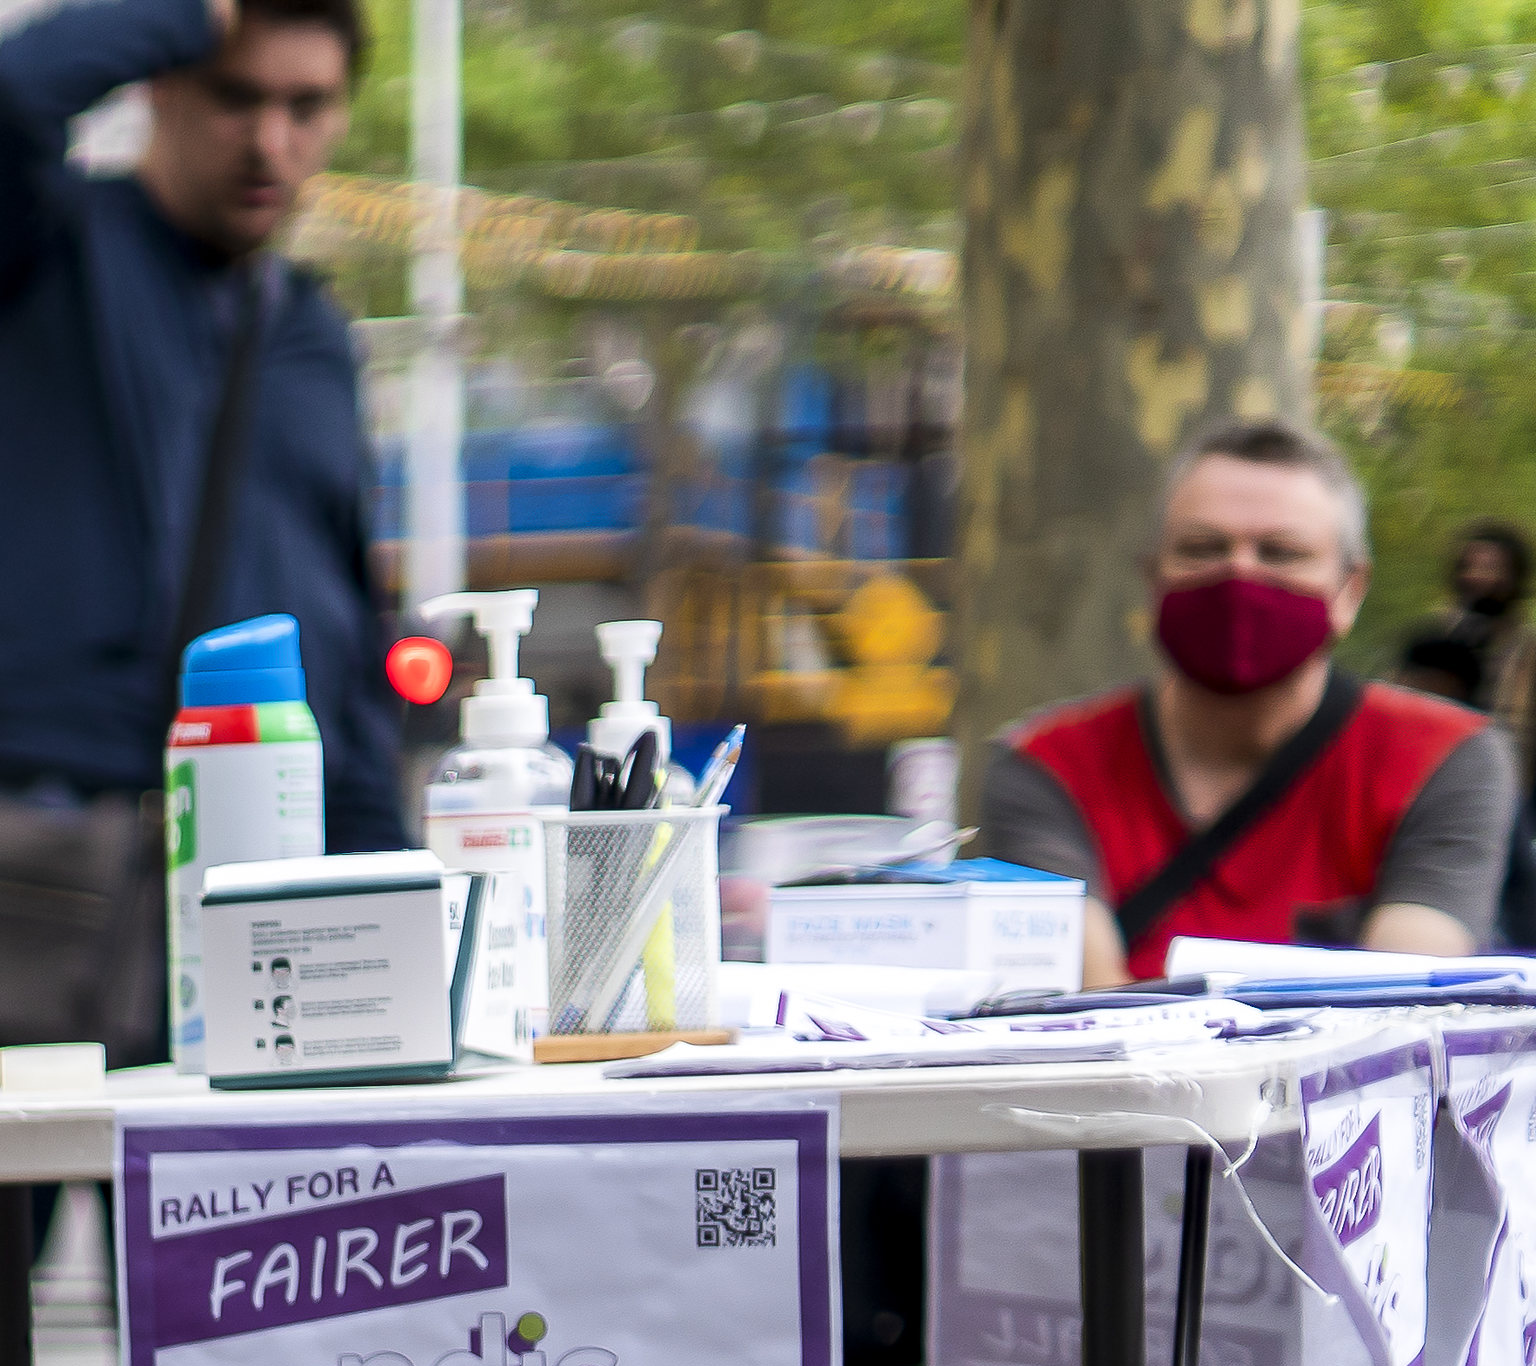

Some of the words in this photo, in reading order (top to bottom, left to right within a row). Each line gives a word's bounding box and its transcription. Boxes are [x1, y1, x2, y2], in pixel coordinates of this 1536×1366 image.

[160, 1180, 273, 1228] RALLY
[287, 1166, 359, 1205] FOR
[372, 1161, 395, 1190] A
[210, 1208, 489, 1321] FAIRER
